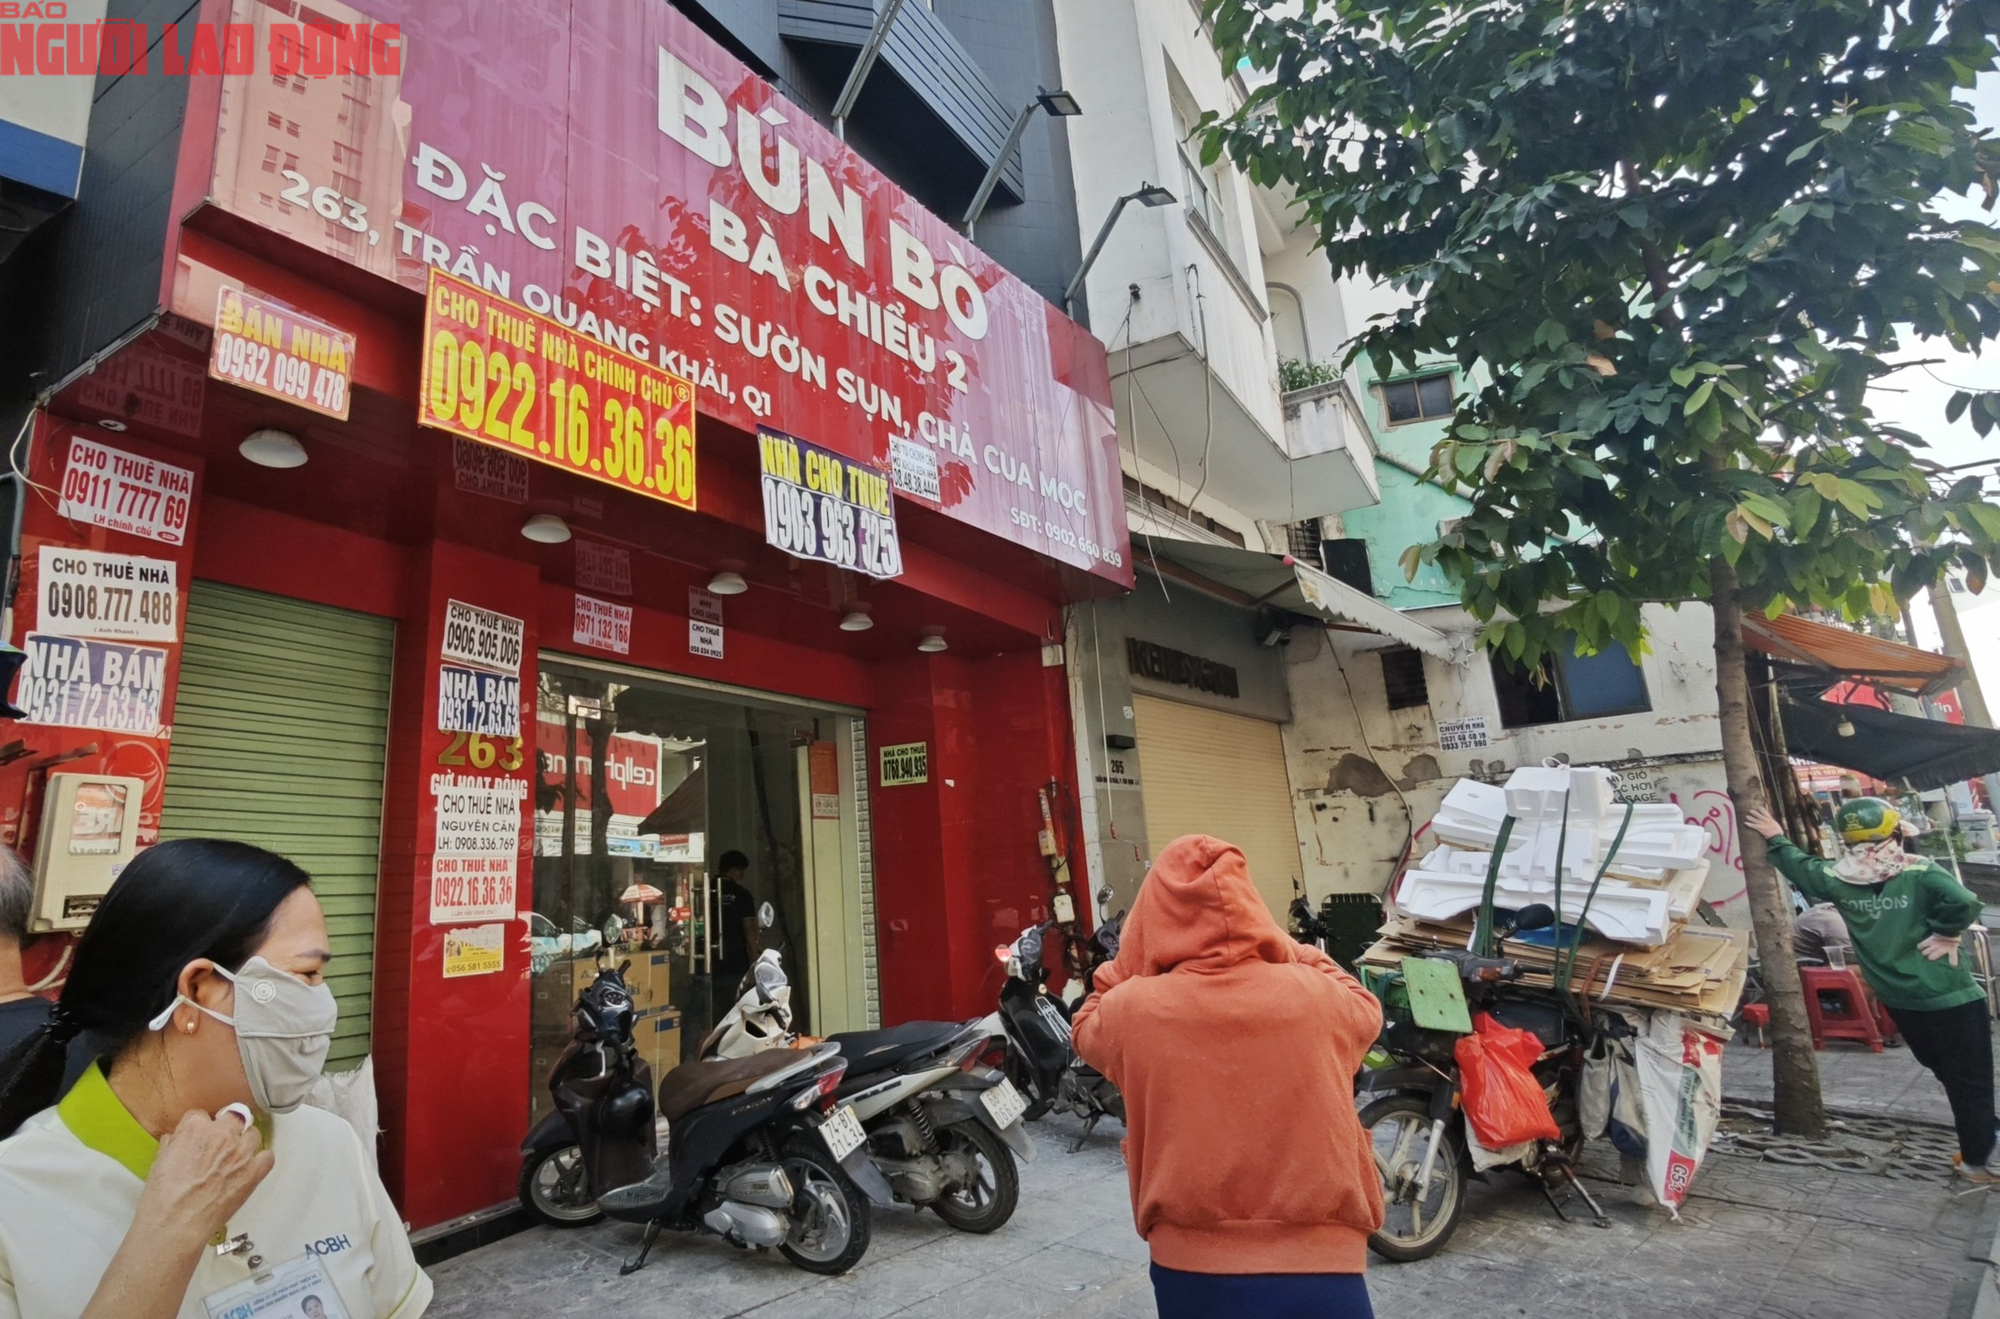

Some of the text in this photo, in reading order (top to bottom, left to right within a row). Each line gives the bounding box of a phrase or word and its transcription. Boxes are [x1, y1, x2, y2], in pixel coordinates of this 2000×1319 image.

[658, 44, 988, 341] BÚN BÒ
[280, 169, 380, 247] 263,
[394, 220, 511, 299] TRẦN
[659, 345, 736, 404] KHẢI,
[742, 385, 771, 416] Q1
[709, 198, 969, 394] BÀ CHIỀU 2
[220, 296, 283, 350] BÁN
[411, 141, 1088, 516] ĐẶC BIỆT: SƯỜN SỤN, CHẢ CUA MỌC
[435, 285, 479, 329] CHO
[486, 306, 536, 354] THUÊ
[542, 331, 579, 372] NHÀ
[585, 351, 636, 395] CHÍNH
[641, 374, 672, 410] CHỦ
[217, 333, 345, 412] 0932 099 478
[430, 330, 692, 501] 0922.16.36.36
[71, 444, 189, 494] CHO THUÊ NHÀ
[760, 433, 891, 516] NHÀ CHO THUÊ
[65, 467, 187, 529] 0911 7777 69
[93, 513, 105, 524] LH
[108, 518, 133, 531] chính
[135, 524, 152, 536] chủ
[820, 497, 857, 567] 963
[860, 511, 898, 575] 325
[1010, 507, 1042, 535] SĐT:
[1044, 521, 1076, 548] 0902
[1102, 547, 1122, 568] 839
[52, 557, 169, 584] CHO THUÊ NHÀ
[48, 581, 172, 625] 0908.777.488
[451, 606, 471, 622] CHO
[475, 613, 498, 630] THUÊ
[576, 598, 630, 622] CHO THUÊ NHÀ
[447, 621, 520, 666] 0906.905.006
[575, 613, 628, 643] 0971 132 168
[692, 623, 720, 637] CHO THUÊ
[700, 636, 713, 646] NHÀ
[25, 640, 163, 690] NHÀ BÁN
[18, 676, 158, 731] 0931.72.63.63
[442, 670, 518, 706] NHÀ BÁN
[440, 696, 518, 736] 0931.72.63.63
[438, 729, 523, 771] 263
[883, 743, 925, 758] NHÀ CHO THUÊ
[443, 792, 516, 815] CHO THUÊ NHÀ
[438, 836, 515, 851] LH: 0908.336.769
[442, 819, 515, 833] NGUYÊN CĂN
[436, 857, 509, 872] CHO THUÊ NHÀ
[435, 876, 513, 907] 0922.16.36.36
[825, 1109, 853, 1139] 74-B1
[832, 1123, 865, 1158] 214.34
[304, 1233, 352, 1260] ACBH
